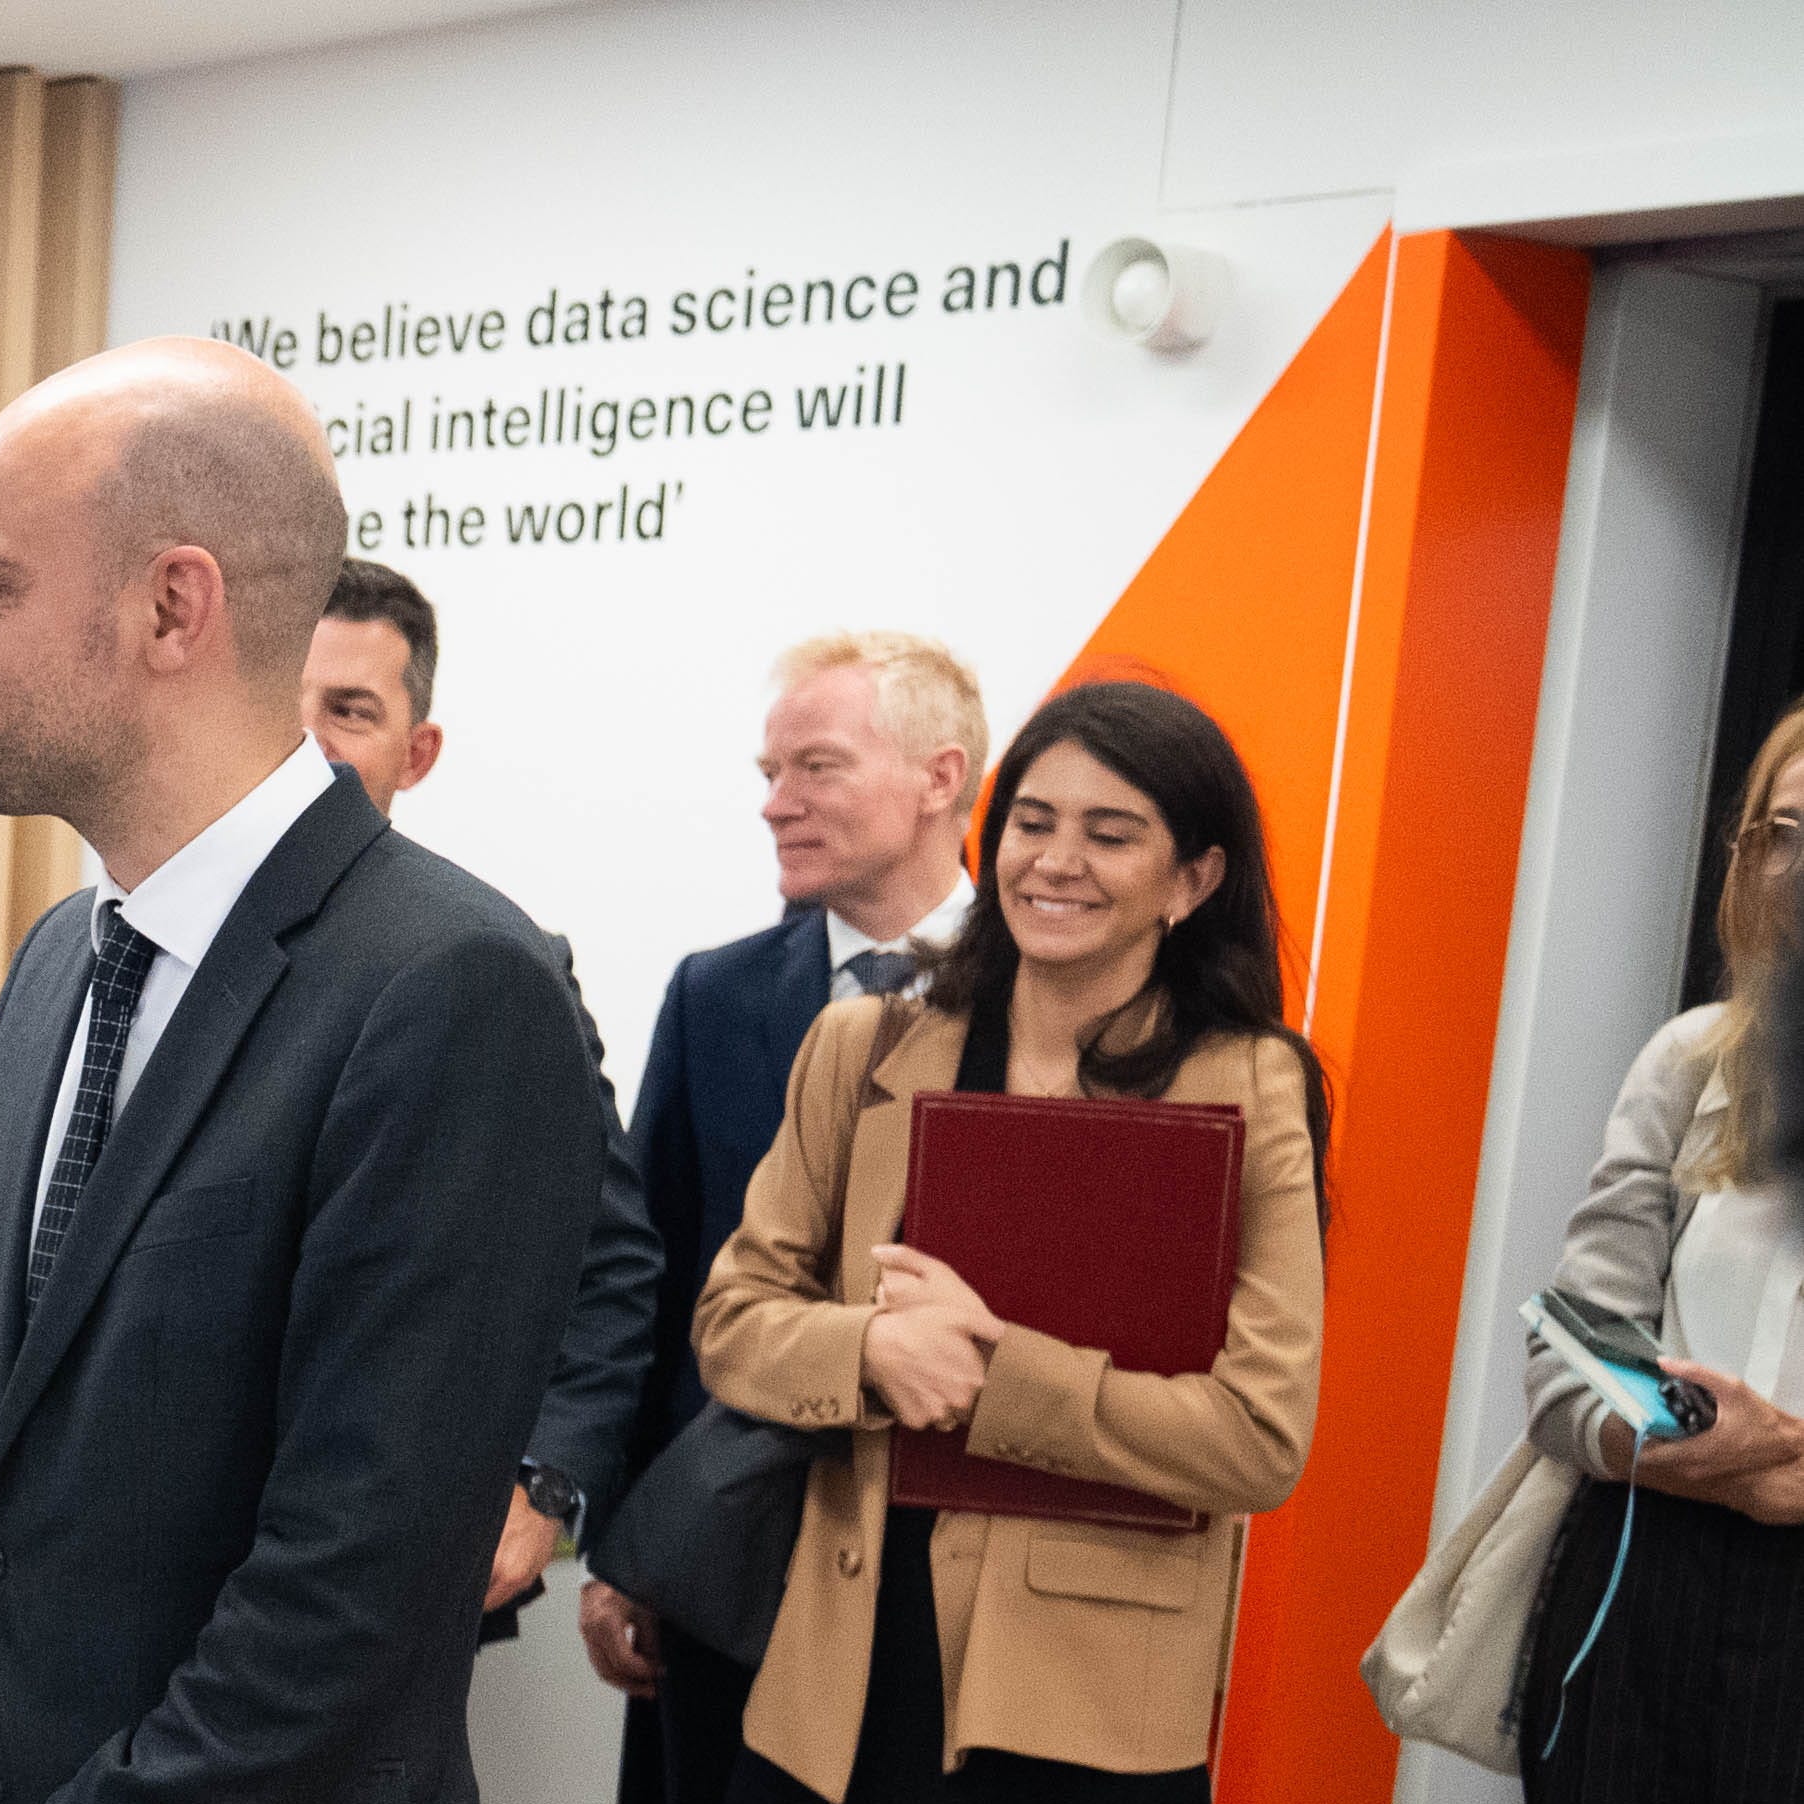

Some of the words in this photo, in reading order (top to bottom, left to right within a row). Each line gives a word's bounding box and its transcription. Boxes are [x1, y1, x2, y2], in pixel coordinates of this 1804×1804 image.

[315, 302, 507, 367] believe
[525, 287, 649, 349] data
[669, 267, 920, 337] science
[940, 236, 1071, 315] and
[430, 386, 774, 459] intelligence
[795, 361, 907, 431] will
[401, 492, 487, 550] the
